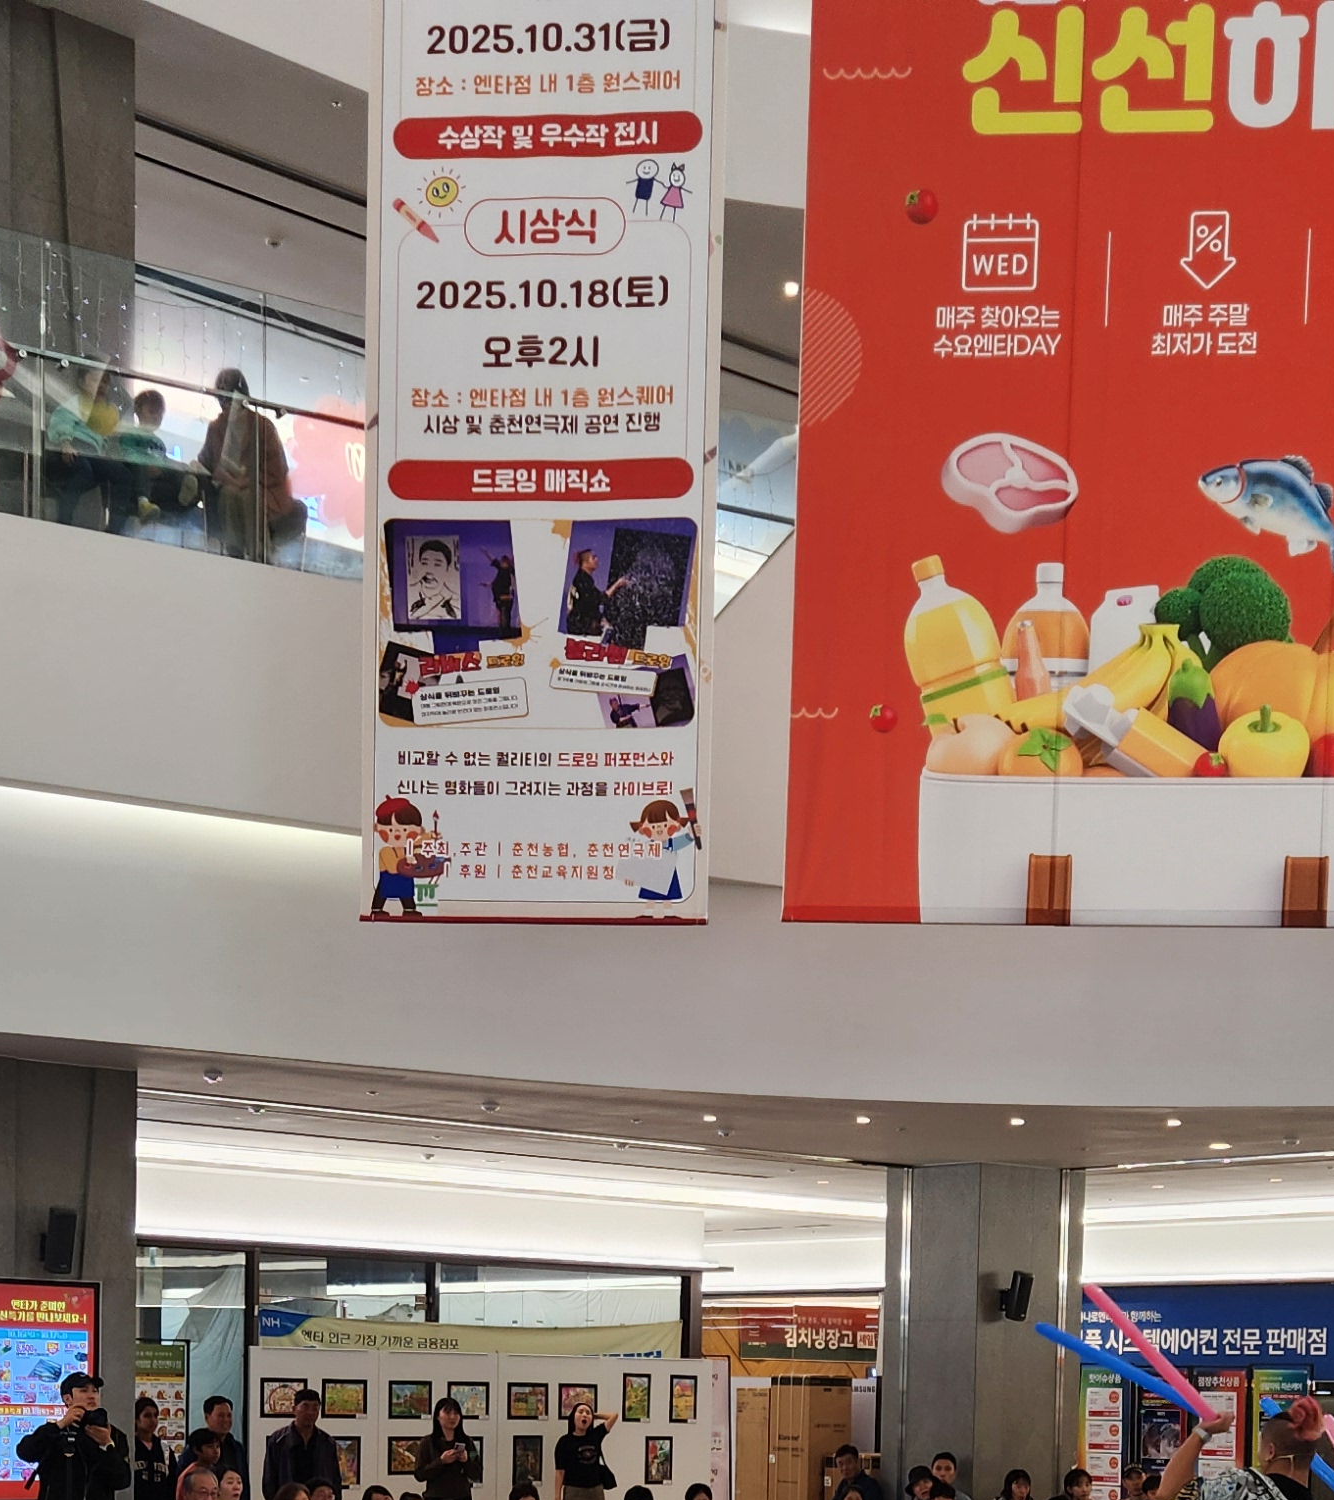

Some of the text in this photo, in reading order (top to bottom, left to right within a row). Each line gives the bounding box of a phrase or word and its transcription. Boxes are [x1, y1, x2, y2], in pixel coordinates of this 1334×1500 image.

[426, 19, 671, 55] 2025.10.31(금)
[415, 76, 454, 97] 장소
[473, 74, 531, 96] 엔타점
[539, 73, 557, 94] 내
[566, 73, 595, 95] 1층
[603, 70, 681, 93] 원스퀘어
[437, 121, 659, 151] 수상작 및 우수작 전시
[493, 207, 597, 245] 시상식
[972, 254, 1029, 277] WED
[416, 275, 669, 311] 2025.10.18(토)
[935, 304, 1060, 331] 매주 찾아오는
[1162, 302, 1251, 329] 매주 주말
[482, 335, 601, 369] 오후2시
[933, 332, 1062, 360] 수요엔타DAY
[1151, 330, 1258, 358] 최저가 도전
[411, 388, 449, 409] 장소
[469, 386, 527, 408] 엔타점
[535, 386, 553, 407] 내
[560, 386, 589, 408] 1층
[597, 384, 674, 406] 원스퀘어
[423, 412, 661, 436] 시상 및 춘천연극제 공연 진행
[471, 467, 611, 494] 드로잉 매직쇼
[398, 750, 675, 767] 비교할 수 없는 퀄리티의 드로잉 퍼포먼스와
[397, 780, 674, 797] 신나는 명화들이 그려지는 과정을 라이브로!
[458, 864, 615, 881] 후원 춘천교육지원청
[262, 1316, 281, 1329] NH
[1130, 1311, 1162, 1324] 함께하는
[301, 1329, 459, 1351] 엔타 인근 가장 가까운 금융점포
[784, 1326, 855, 1351] 김치냉장고
[1222, 1328, 1263, 1355] 전문
[1265, 1327, 1328, 1356] 판매점
[852, 1385, 876, 1394] MSUNG
